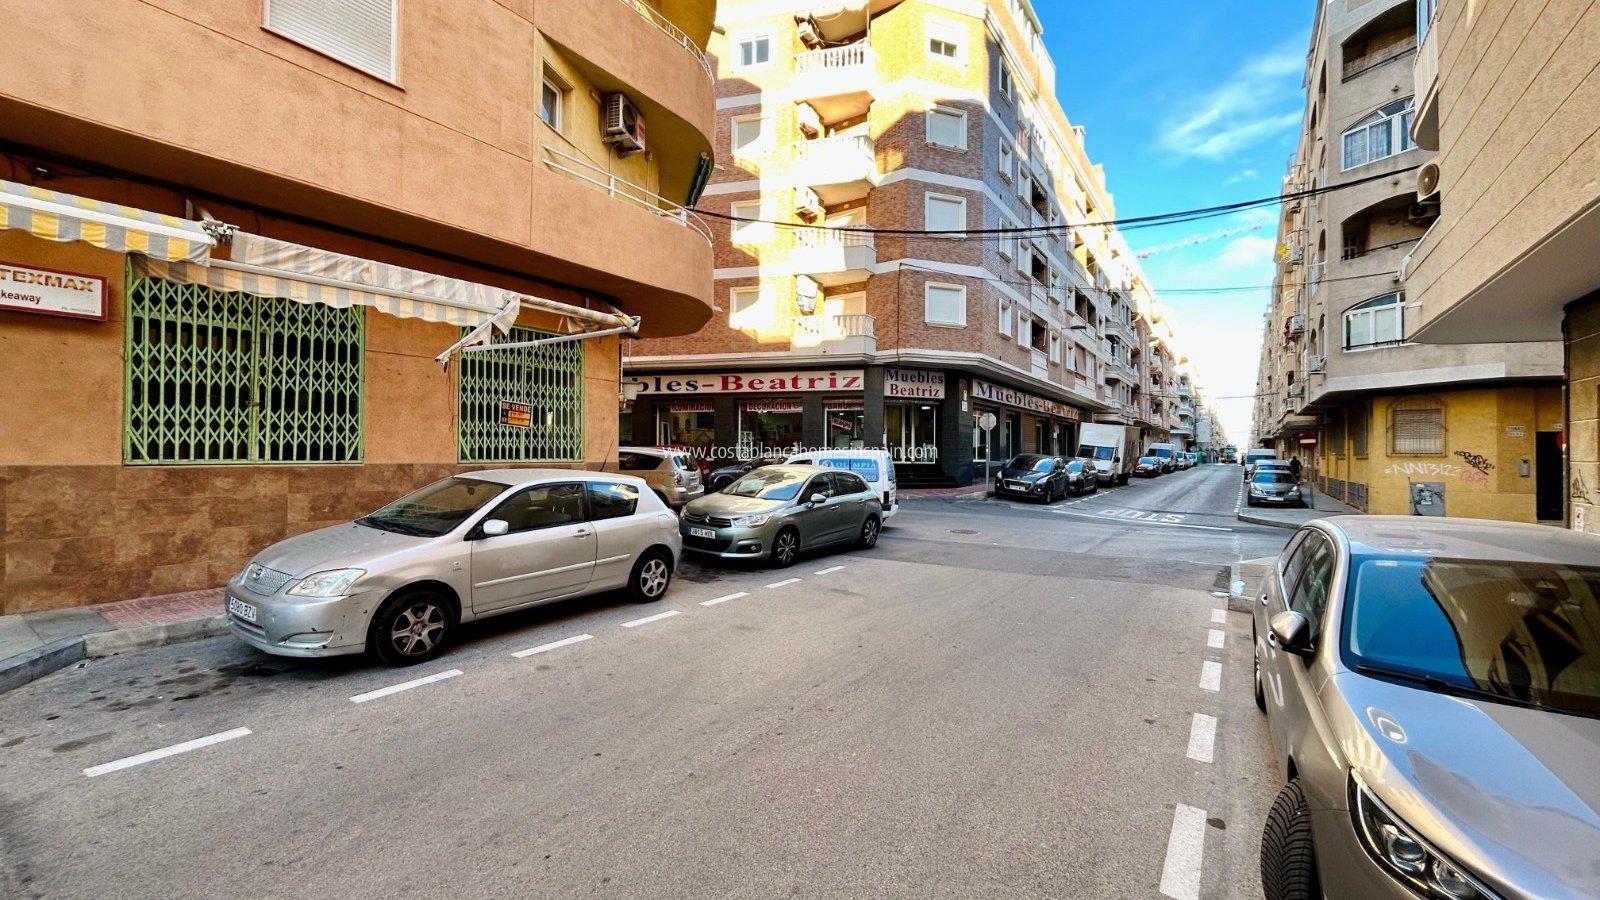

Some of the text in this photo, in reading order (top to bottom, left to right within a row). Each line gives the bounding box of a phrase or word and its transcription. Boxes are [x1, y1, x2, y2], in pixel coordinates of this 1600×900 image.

[0, 269, 93, 292] TEXMAX
[886, 369, 944, 383] Muebles
[890, 383, 940, 397] Beatriz
[502, 402, 531, 413] SE VENDE
[976, 382, 1078, 419] Muebles-Beatriz
[1098, 509, 1185, 523] STOP
